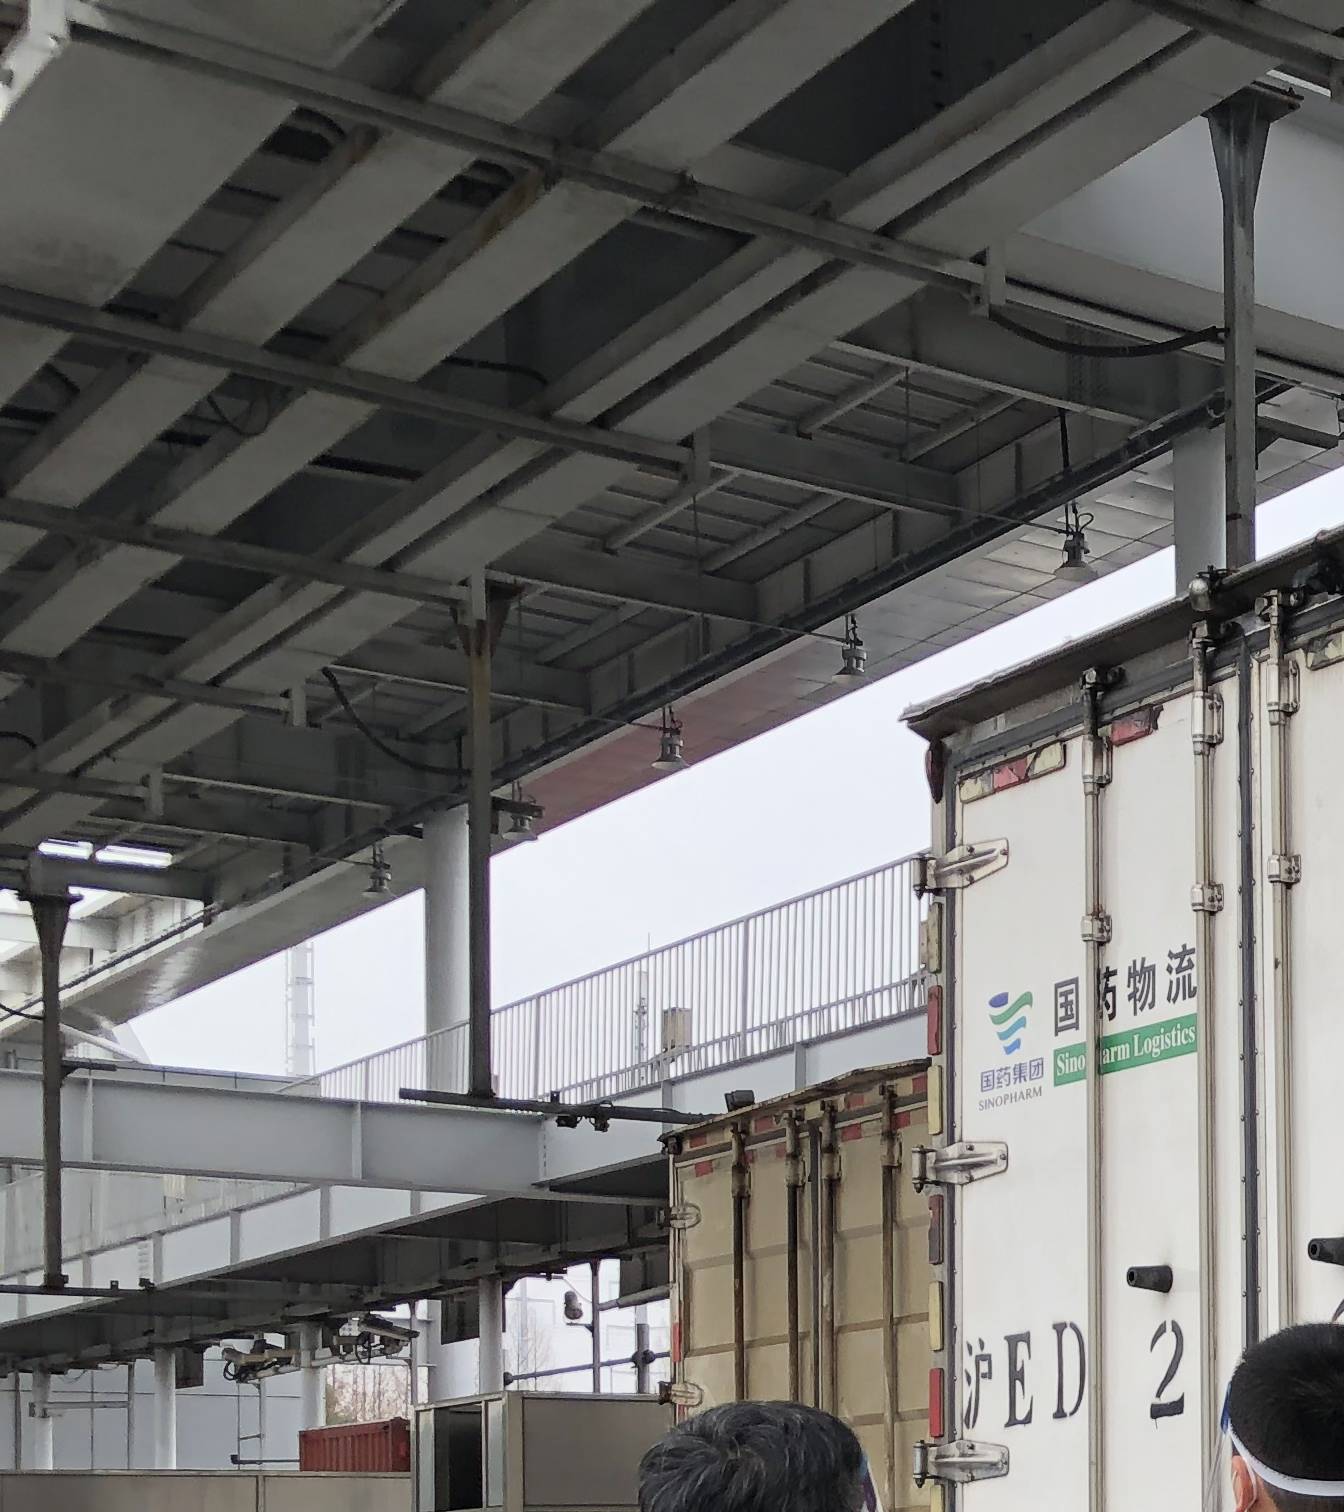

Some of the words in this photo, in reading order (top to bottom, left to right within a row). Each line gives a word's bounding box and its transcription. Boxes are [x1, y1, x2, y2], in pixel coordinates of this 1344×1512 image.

[1056, 1042, 1130, 1077] Sinoarm
[1133, 1024, 1196, 1057] Logistics
[981, 1057, 1044, 1092] 国药集团
[978, 1086, 1043, 1111] SINOPHARM
